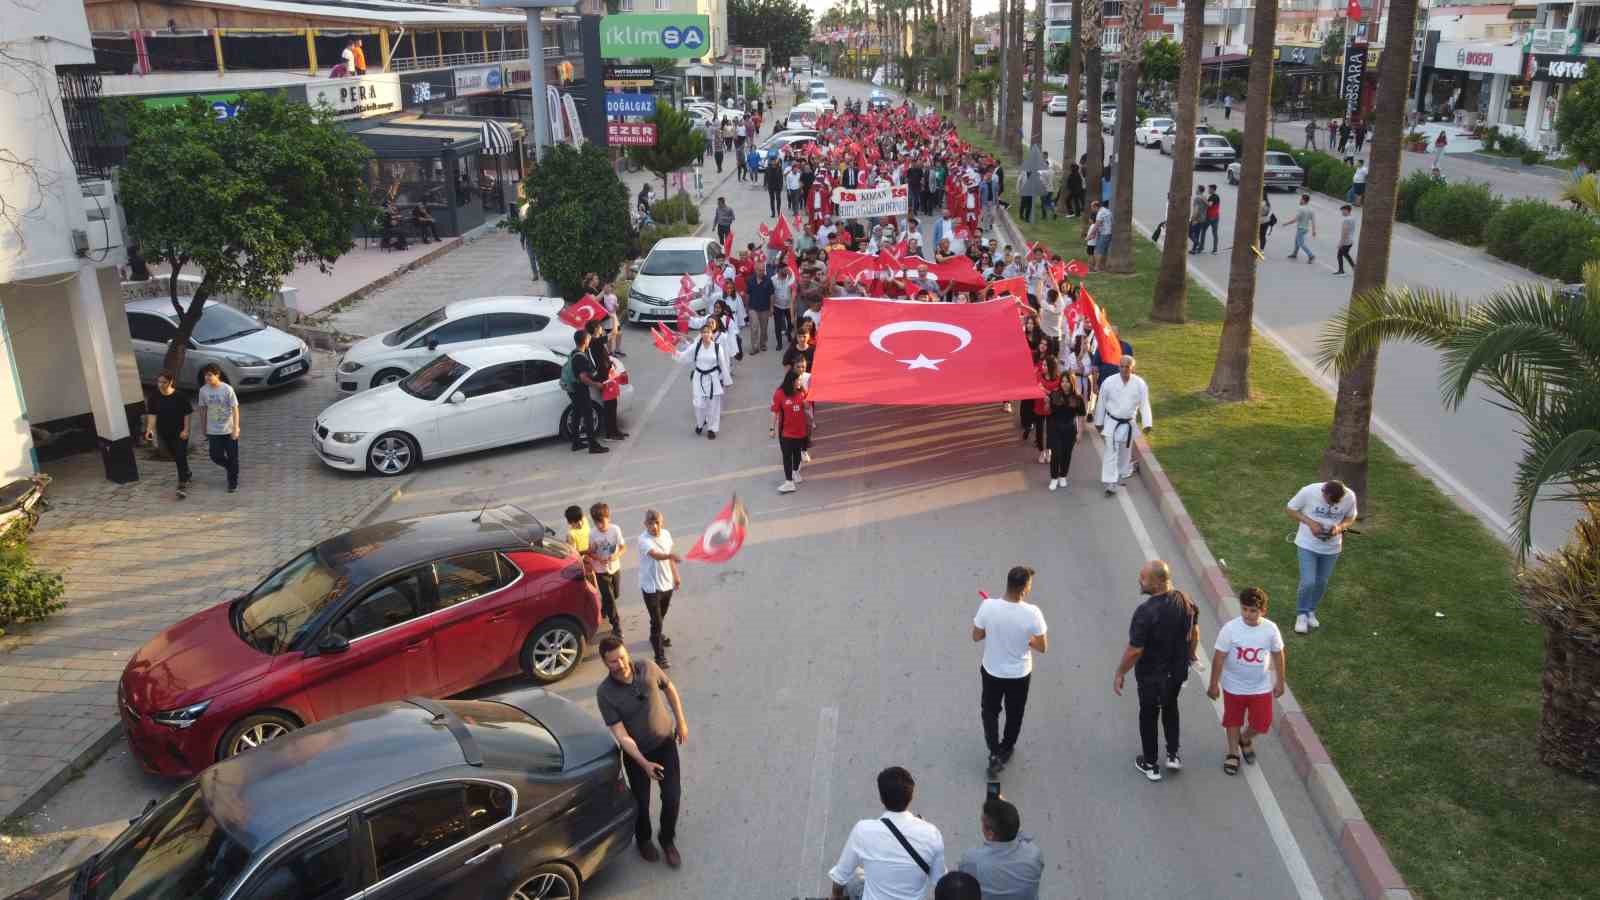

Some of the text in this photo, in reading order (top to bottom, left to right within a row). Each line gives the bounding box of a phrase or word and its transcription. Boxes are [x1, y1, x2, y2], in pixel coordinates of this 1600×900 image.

[340, 84, 377, 103] PERA
[607, 98, 652, 112] DOĞALGAZ
[608, 126, 653, 135] EZER
[861, 190, 887, 201] KOZAN
